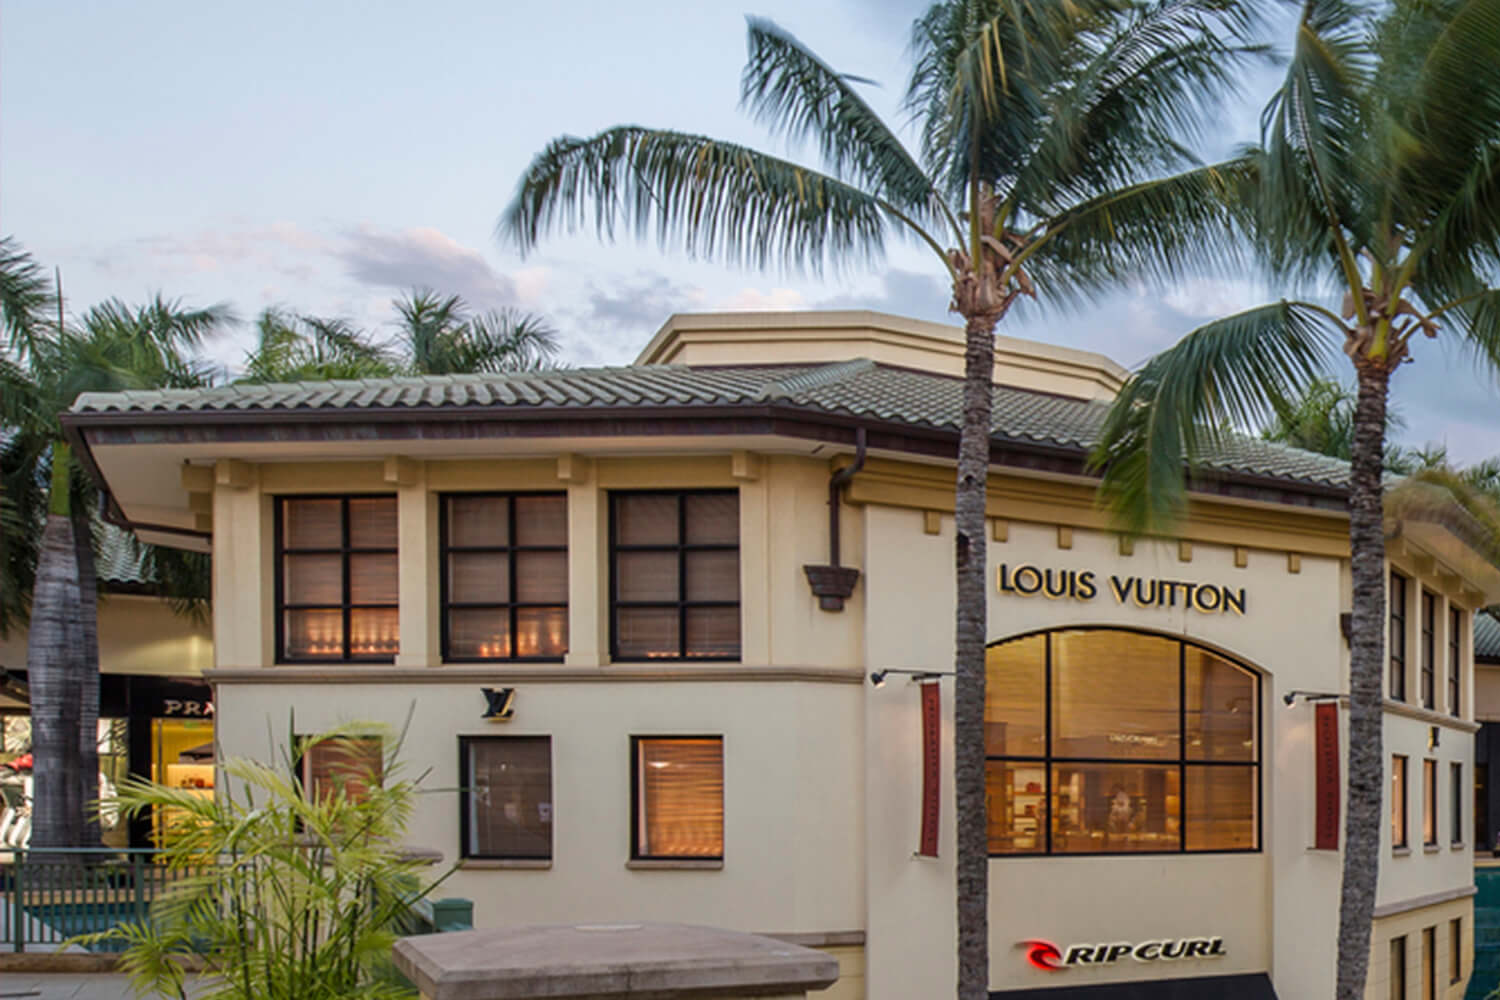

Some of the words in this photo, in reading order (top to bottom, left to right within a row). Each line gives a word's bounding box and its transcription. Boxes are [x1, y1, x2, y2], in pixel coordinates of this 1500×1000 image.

[998, 563, 1098, 600] LOUIS
[1109, 575, 1246, 615] VUITTON
[163, 699, 216, 716] PRA
